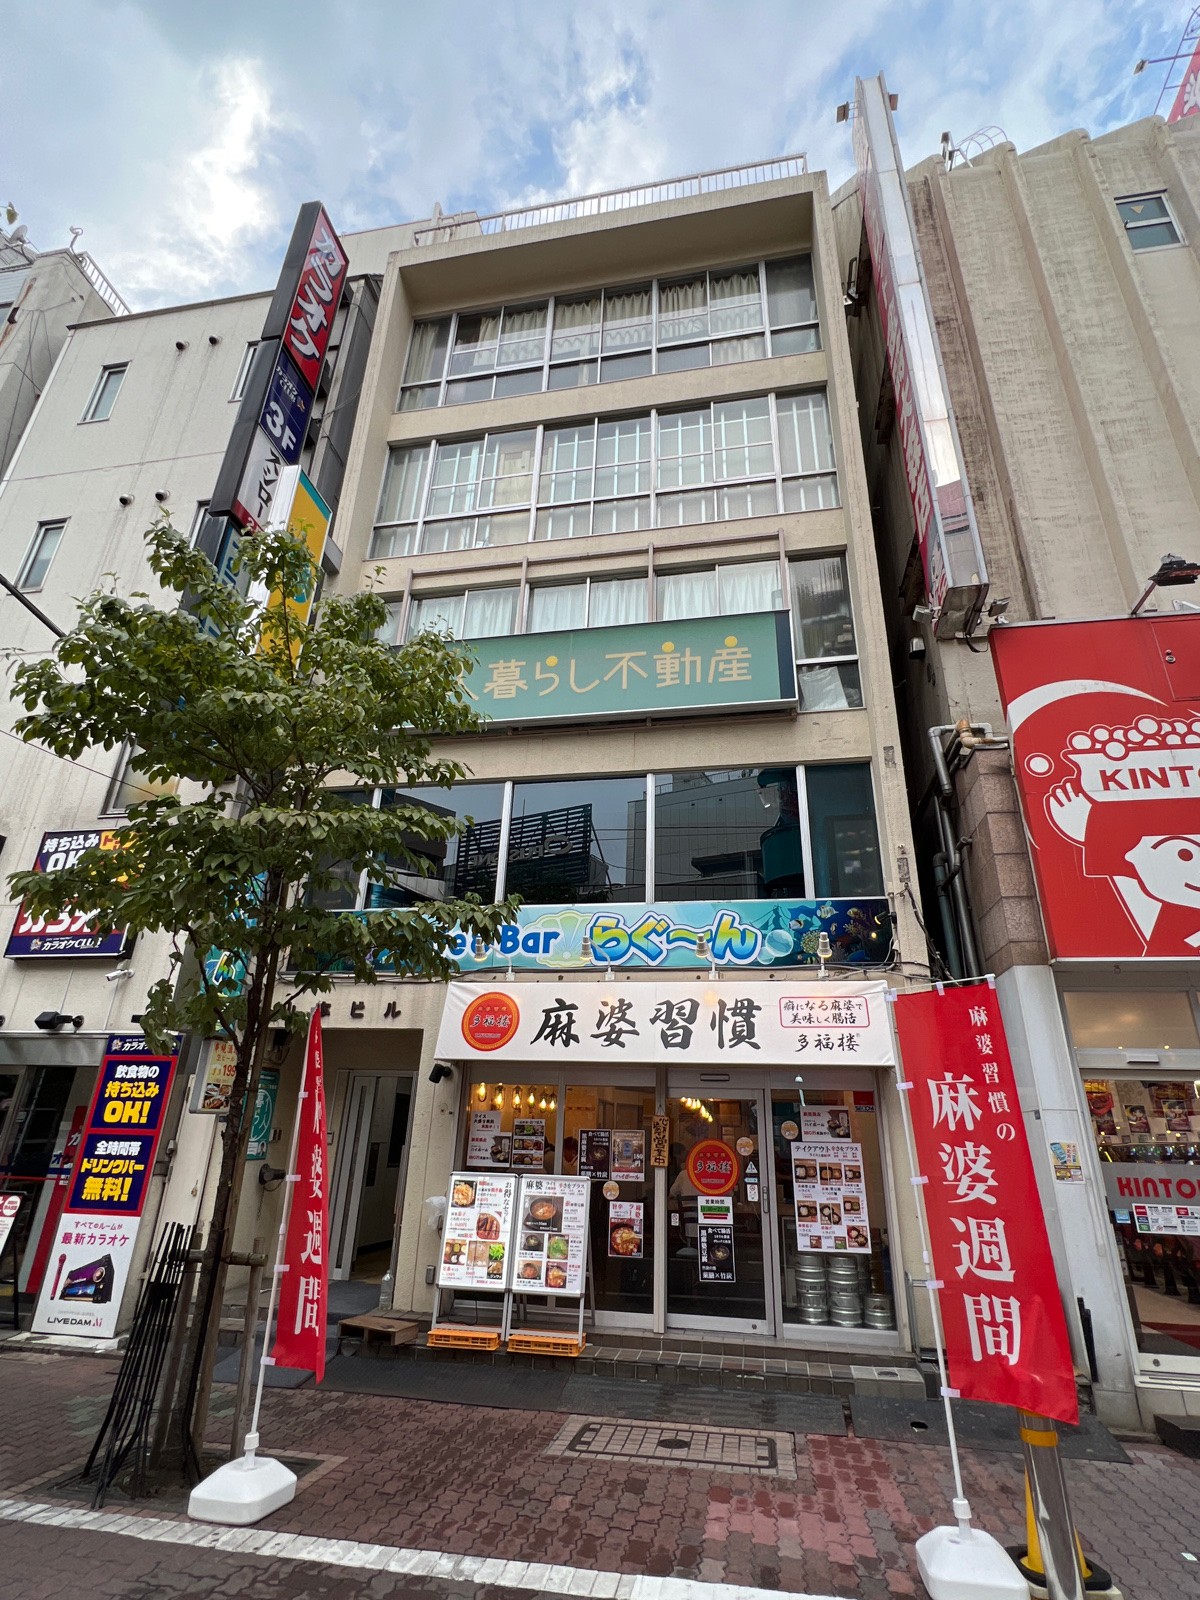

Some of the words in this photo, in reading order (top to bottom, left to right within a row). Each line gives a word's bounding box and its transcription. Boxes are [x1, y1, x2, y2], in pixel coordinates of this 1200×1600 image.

[265, 401, 297, 451] 3F
[1099, 766, 1200, 790] KINT
[43, 833, 99, 853] 持ち込み
[19, 904, 117, 933] カラオ
[531, 998, 762, 1051] 麻婆習慣
[790, 1013, 857, 1024] 美味しく腸活
[115, 1065, 160, 1079] 飲食物の
[968, 1005, 1017, 1142] 麻婆習慣の
[104, 1081, 159, 1098] 持ち込み
[103, 1101, 151, 1124] OK!
[94, 1141, 142, 1156] 全時間帯
[80, 1158, 145, 1174] ドリンクバー
[81, 1176, 133, 1202] 無料!
[1117, 1176, 1200, 1200] KINTO
[74, 1221, 123, 1231] すべてのルームが
[926, 1072, 1022, 1367] 麻婆週間
[61, 1232, 130, 1247] 最新カラオケ
